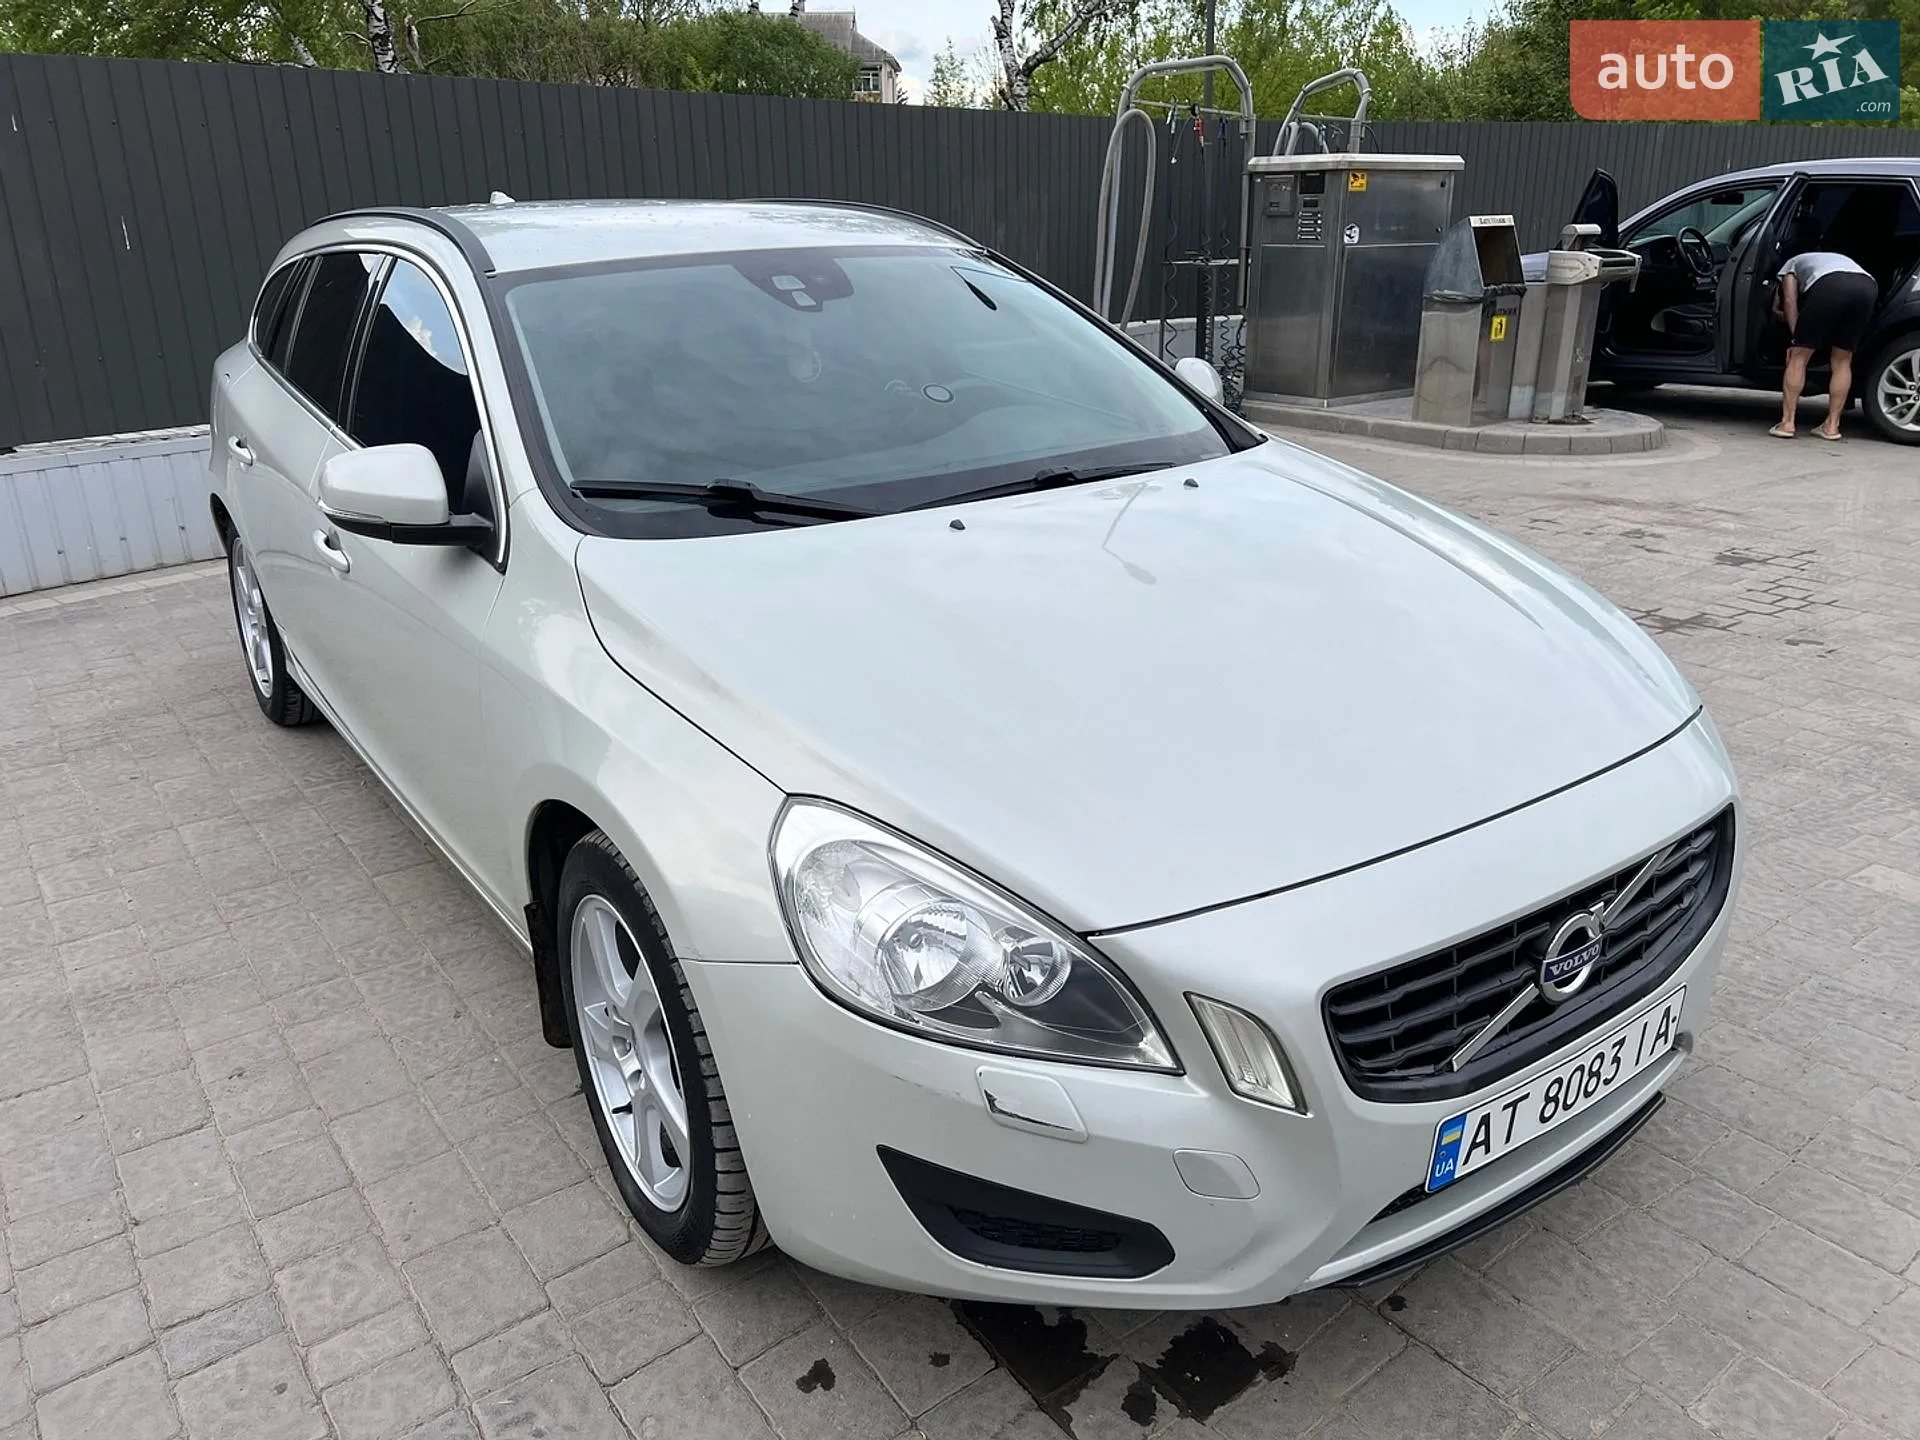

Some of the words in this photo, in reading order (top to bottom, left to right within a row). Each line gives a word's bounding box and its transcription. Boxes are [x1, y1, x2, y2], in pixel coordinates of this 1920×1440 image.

[1549, 944, 1599, 976] VOLVO
[1462, 1093, 1530, 1166] AT
[1539, 1034, 1627, 1124] 8083
[1635, 1002, 1674, 1066] IA
[1435, 1158, 1454, 1177] UA
